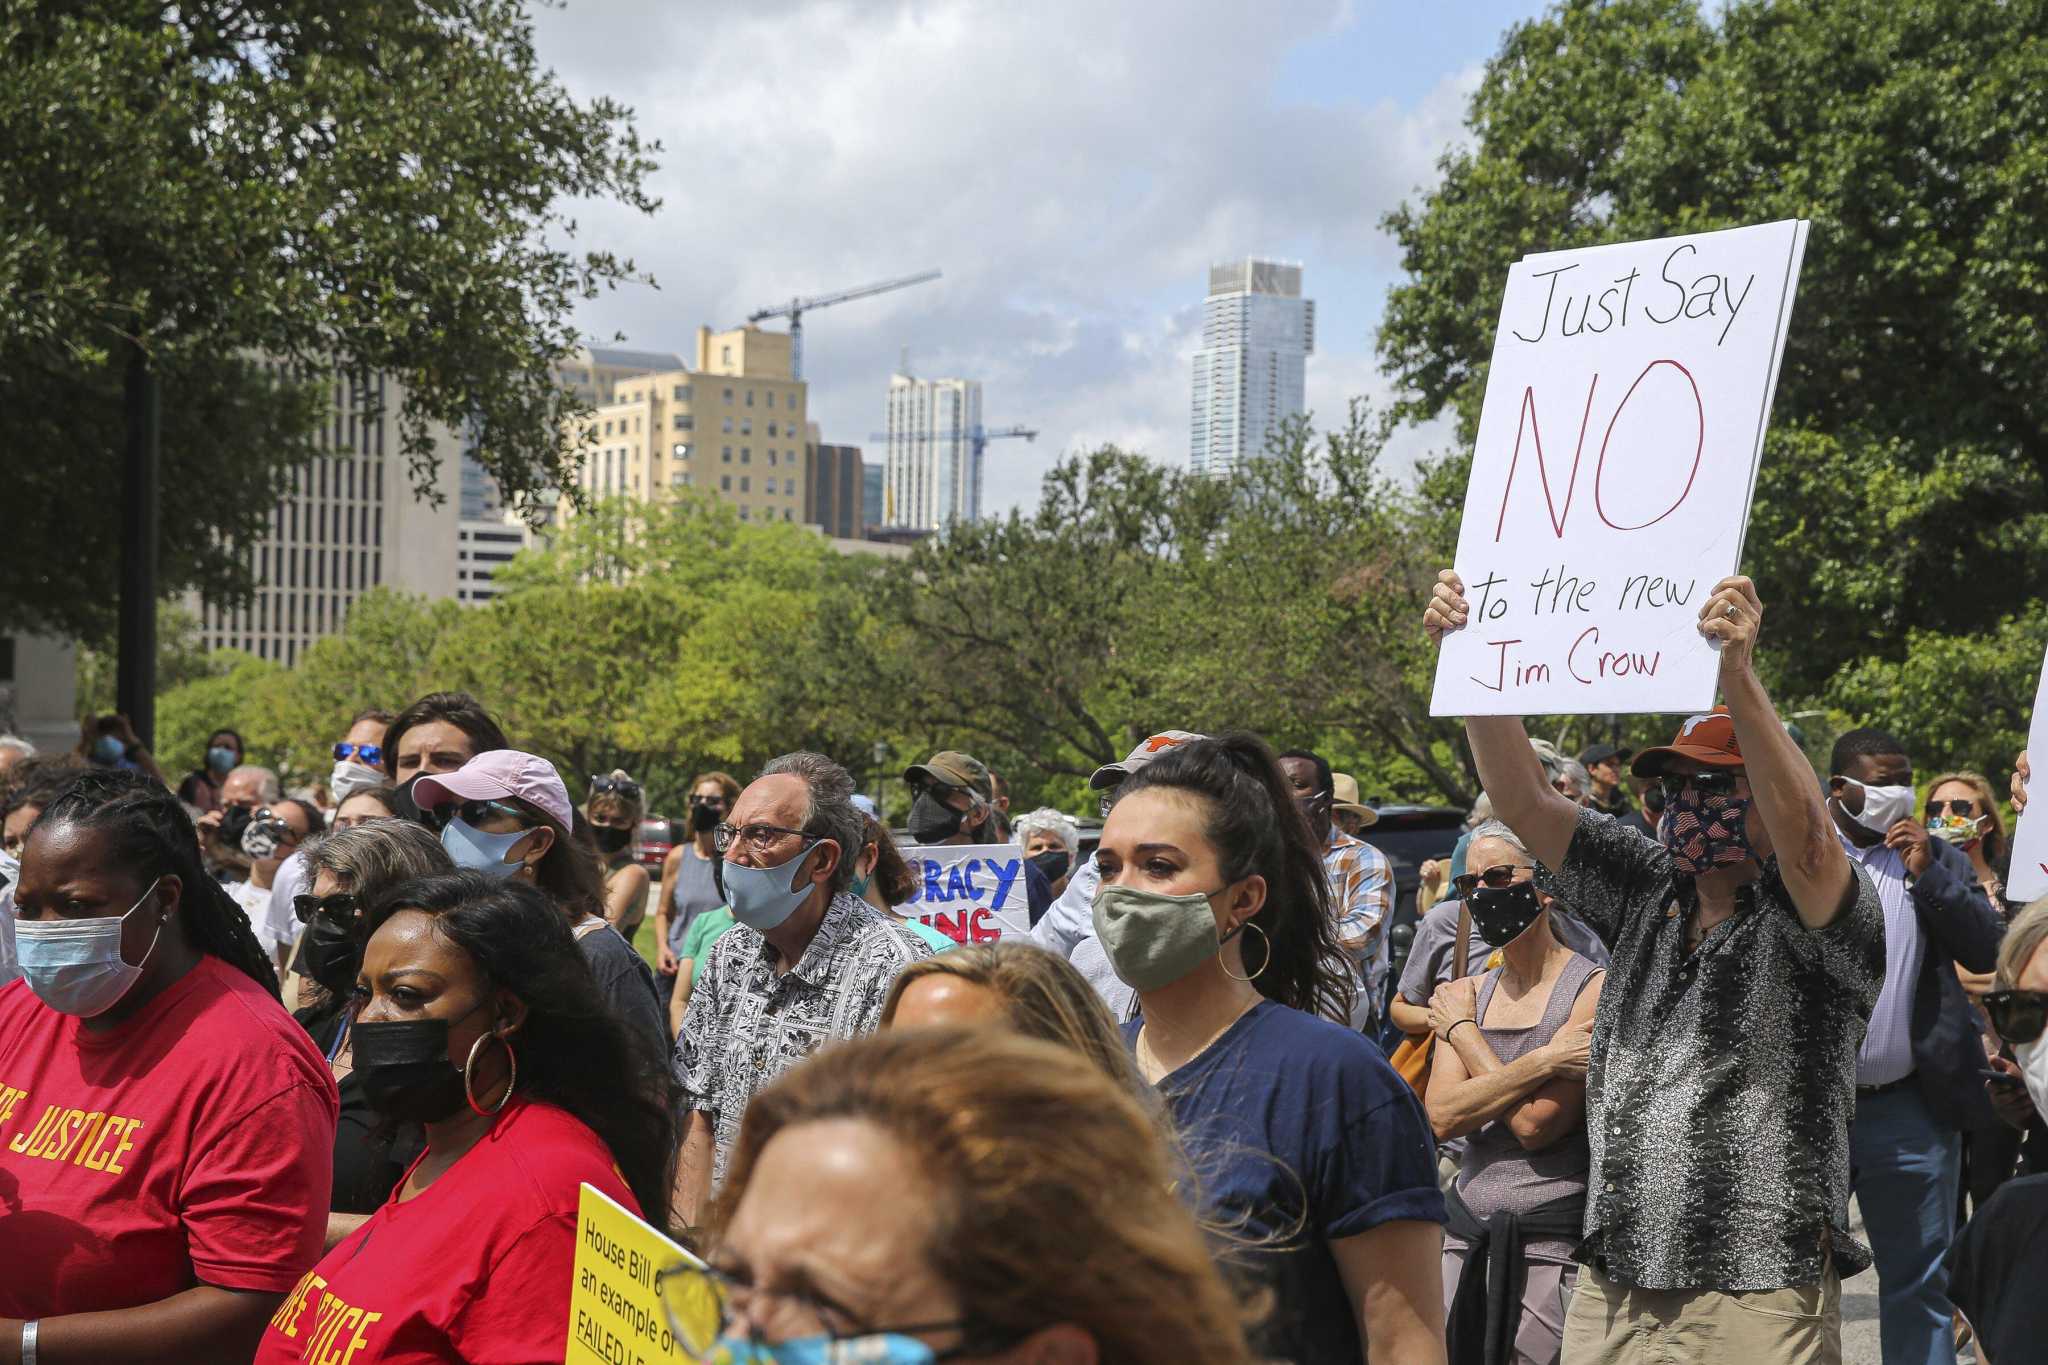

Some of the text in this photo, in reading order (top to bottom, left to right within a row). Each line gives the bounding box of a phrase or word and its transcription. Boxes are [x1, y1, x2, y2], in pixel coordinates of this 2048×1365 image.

[1513, 244, 1754, 346] Just Say
[1496, 359, 1704, 542] NO
[1472, 565, 1695, 623] to the new
[1470, 627, 1660, 692] Jim Crow
[9, 1104, 141, 1174] JUSTICE
[584, 1218, 625, 1270] House
[629, 1250, 651, 1289] Bill
[577, 1310, 624, 1365] FAILED
[581, 1267, 597, 1297] an
[600, 1282, 657, 1343] example
